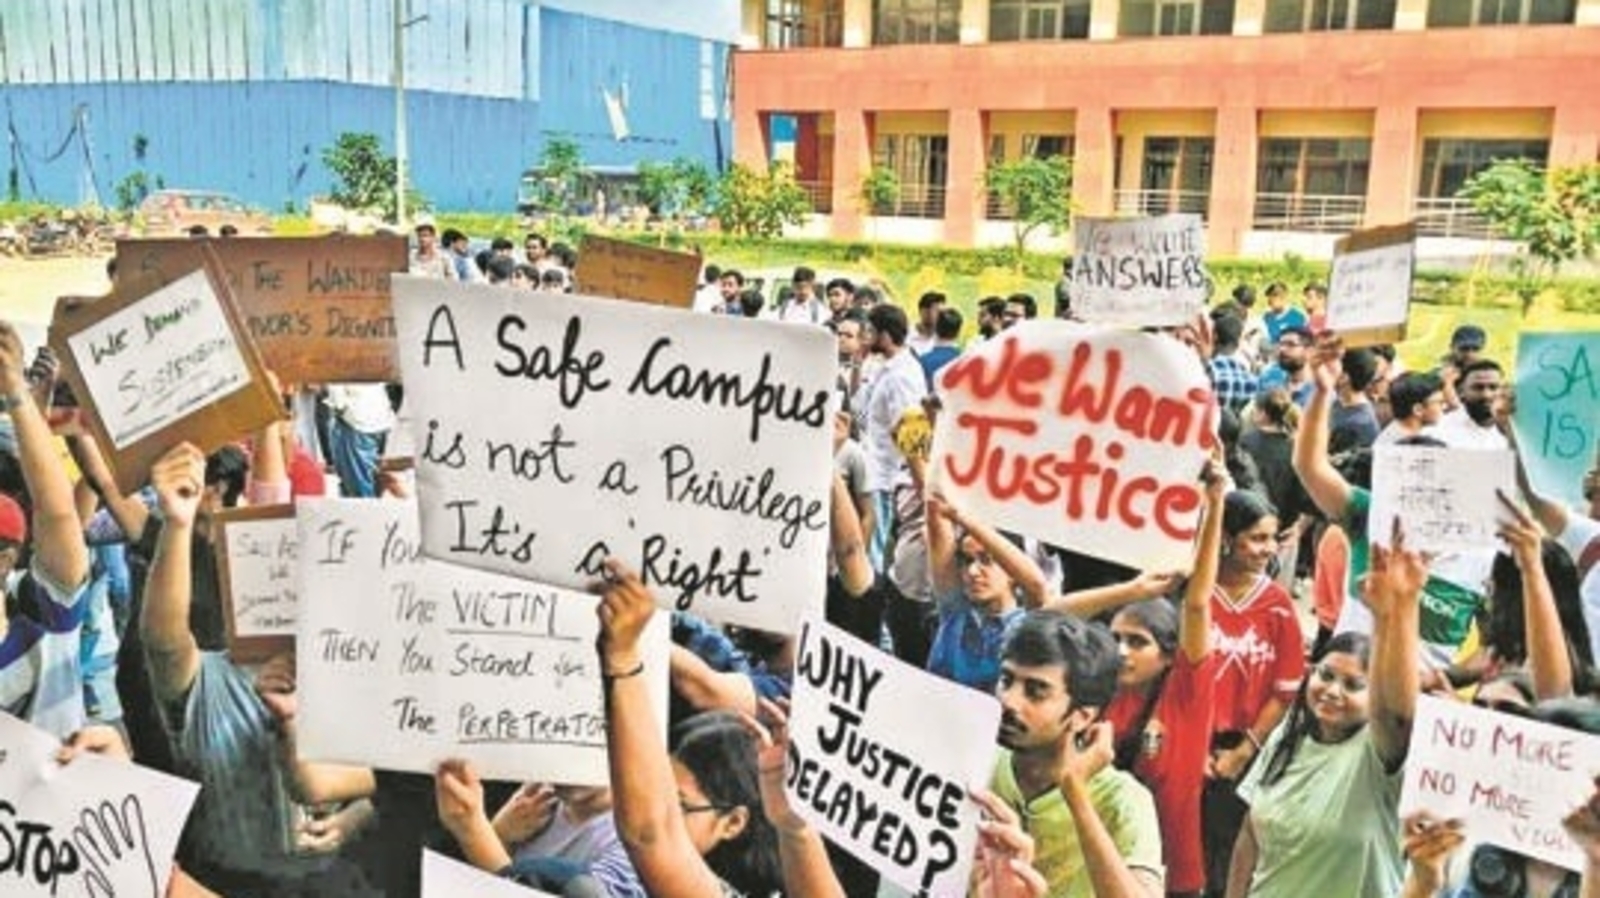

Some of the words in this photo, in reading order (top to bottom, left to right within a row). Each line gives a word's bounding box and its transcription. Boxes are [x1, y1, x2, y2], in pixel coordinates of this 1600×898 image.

[253, 260, 283, 291] THE
[1076, 255, 1203, 291] ANSWERS
[423, 304, 466, 371] A
[494, 315, 611, 408] Safe
[628, 337, 828, 442] Campus
[942, 336, 1054, 408] We
[1058, 340, 1216, 450] Want
[1543, 409, 1586, 460] IS
[422, 420, 467, 468] is
[486, 424, 577, 484] not
[600, 462, 639, 495] a
[660, 444, 827, 548] Privilege
[944, 411, 1201, 541] Justice
[318, 519, 360, 563] IF
[445, 501, 537, 564] It's
[575, 540, 612, 576] a
[392, 580, 437, 625] The
[450, 589, 559, 637] VICTIM
[321, 628, 380, 663] THEN
[399, 635, 434, 677] You
[450, 641, 535, 678] Stand
[798, 622, 883, 712] WHY
[393, 697, 437, 735] The
[818, 703, 964, 829] JUSTICE
[1431, 718, 1477, 749] NO
[1492, 724, 1573, 772] MORE
[1419, 768, 1457, 796] NO
[1469, 779, 1531, 819] MORE
